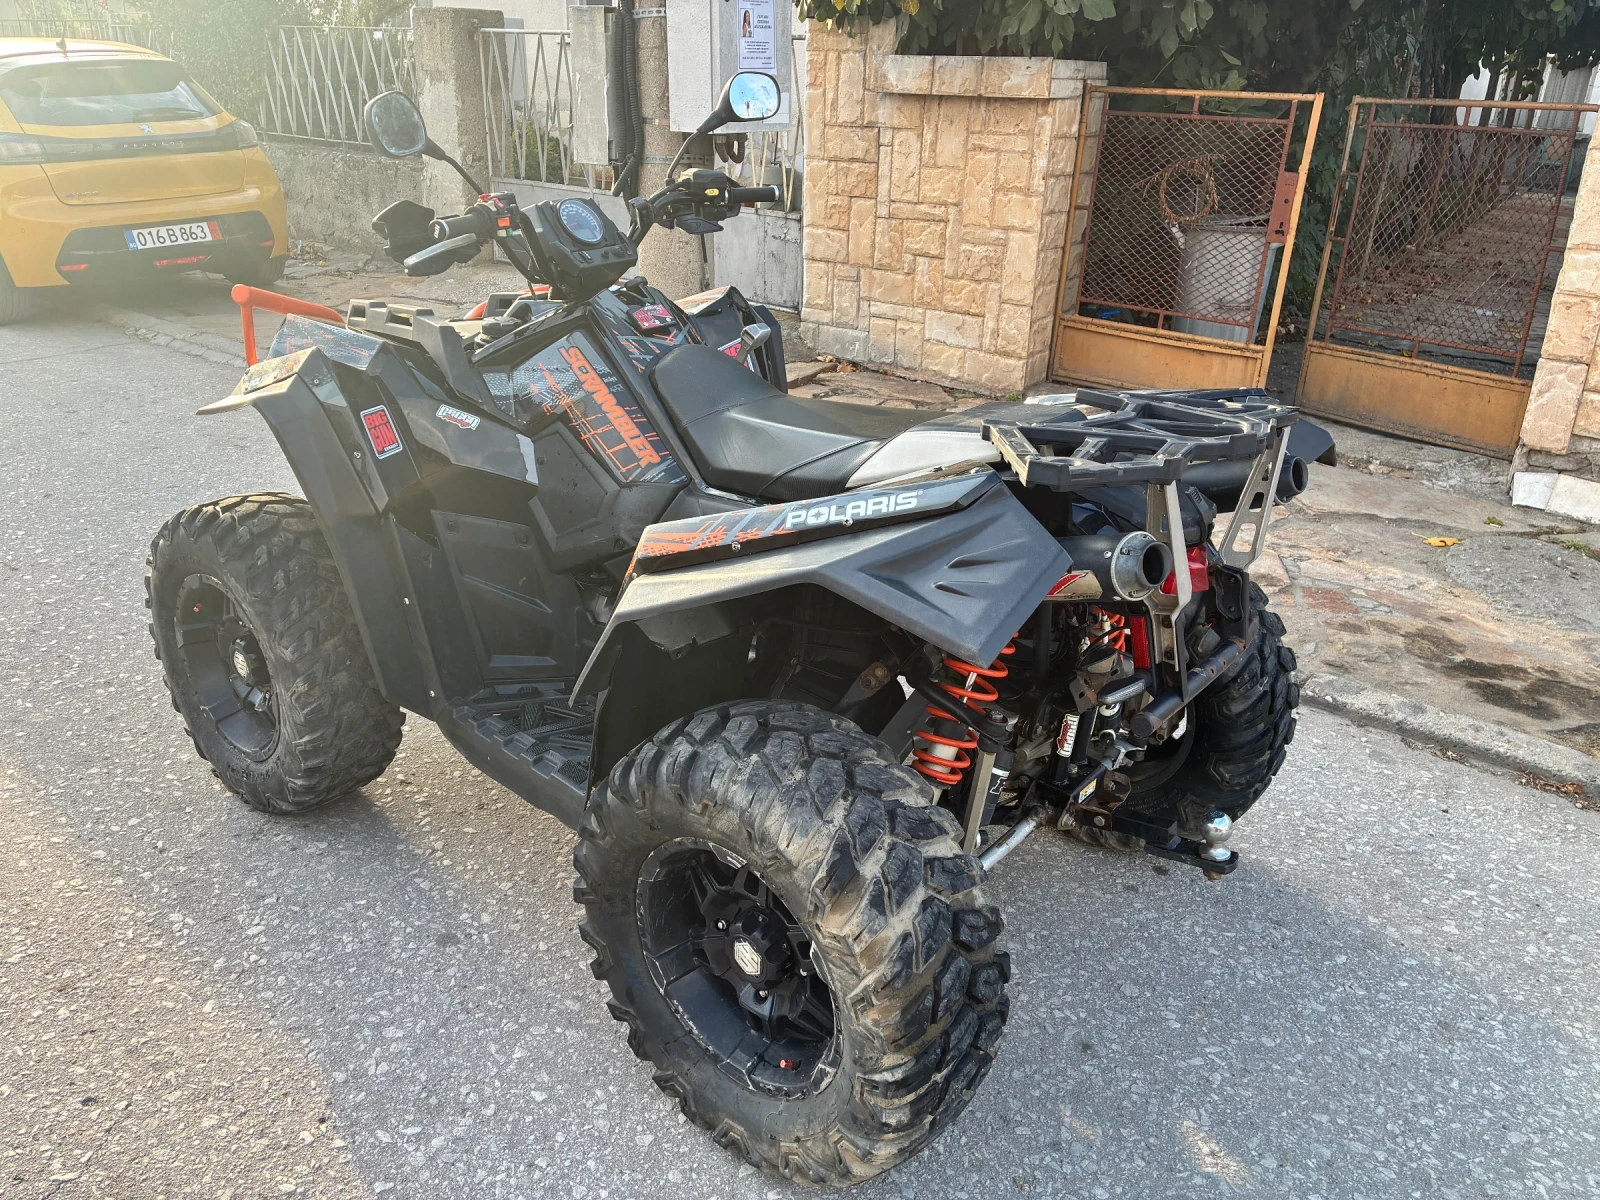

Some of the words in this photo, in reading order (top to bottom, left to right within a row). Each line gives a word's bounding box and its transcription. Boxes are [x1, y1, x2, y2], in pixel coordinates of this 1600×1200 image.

[364, 411, 388, 428] BIG
[558, 346, 661, 468] SCRAMBLER
[370, 424, 398, 451] GUN
[785, 491, 918, 528] POLARIS
